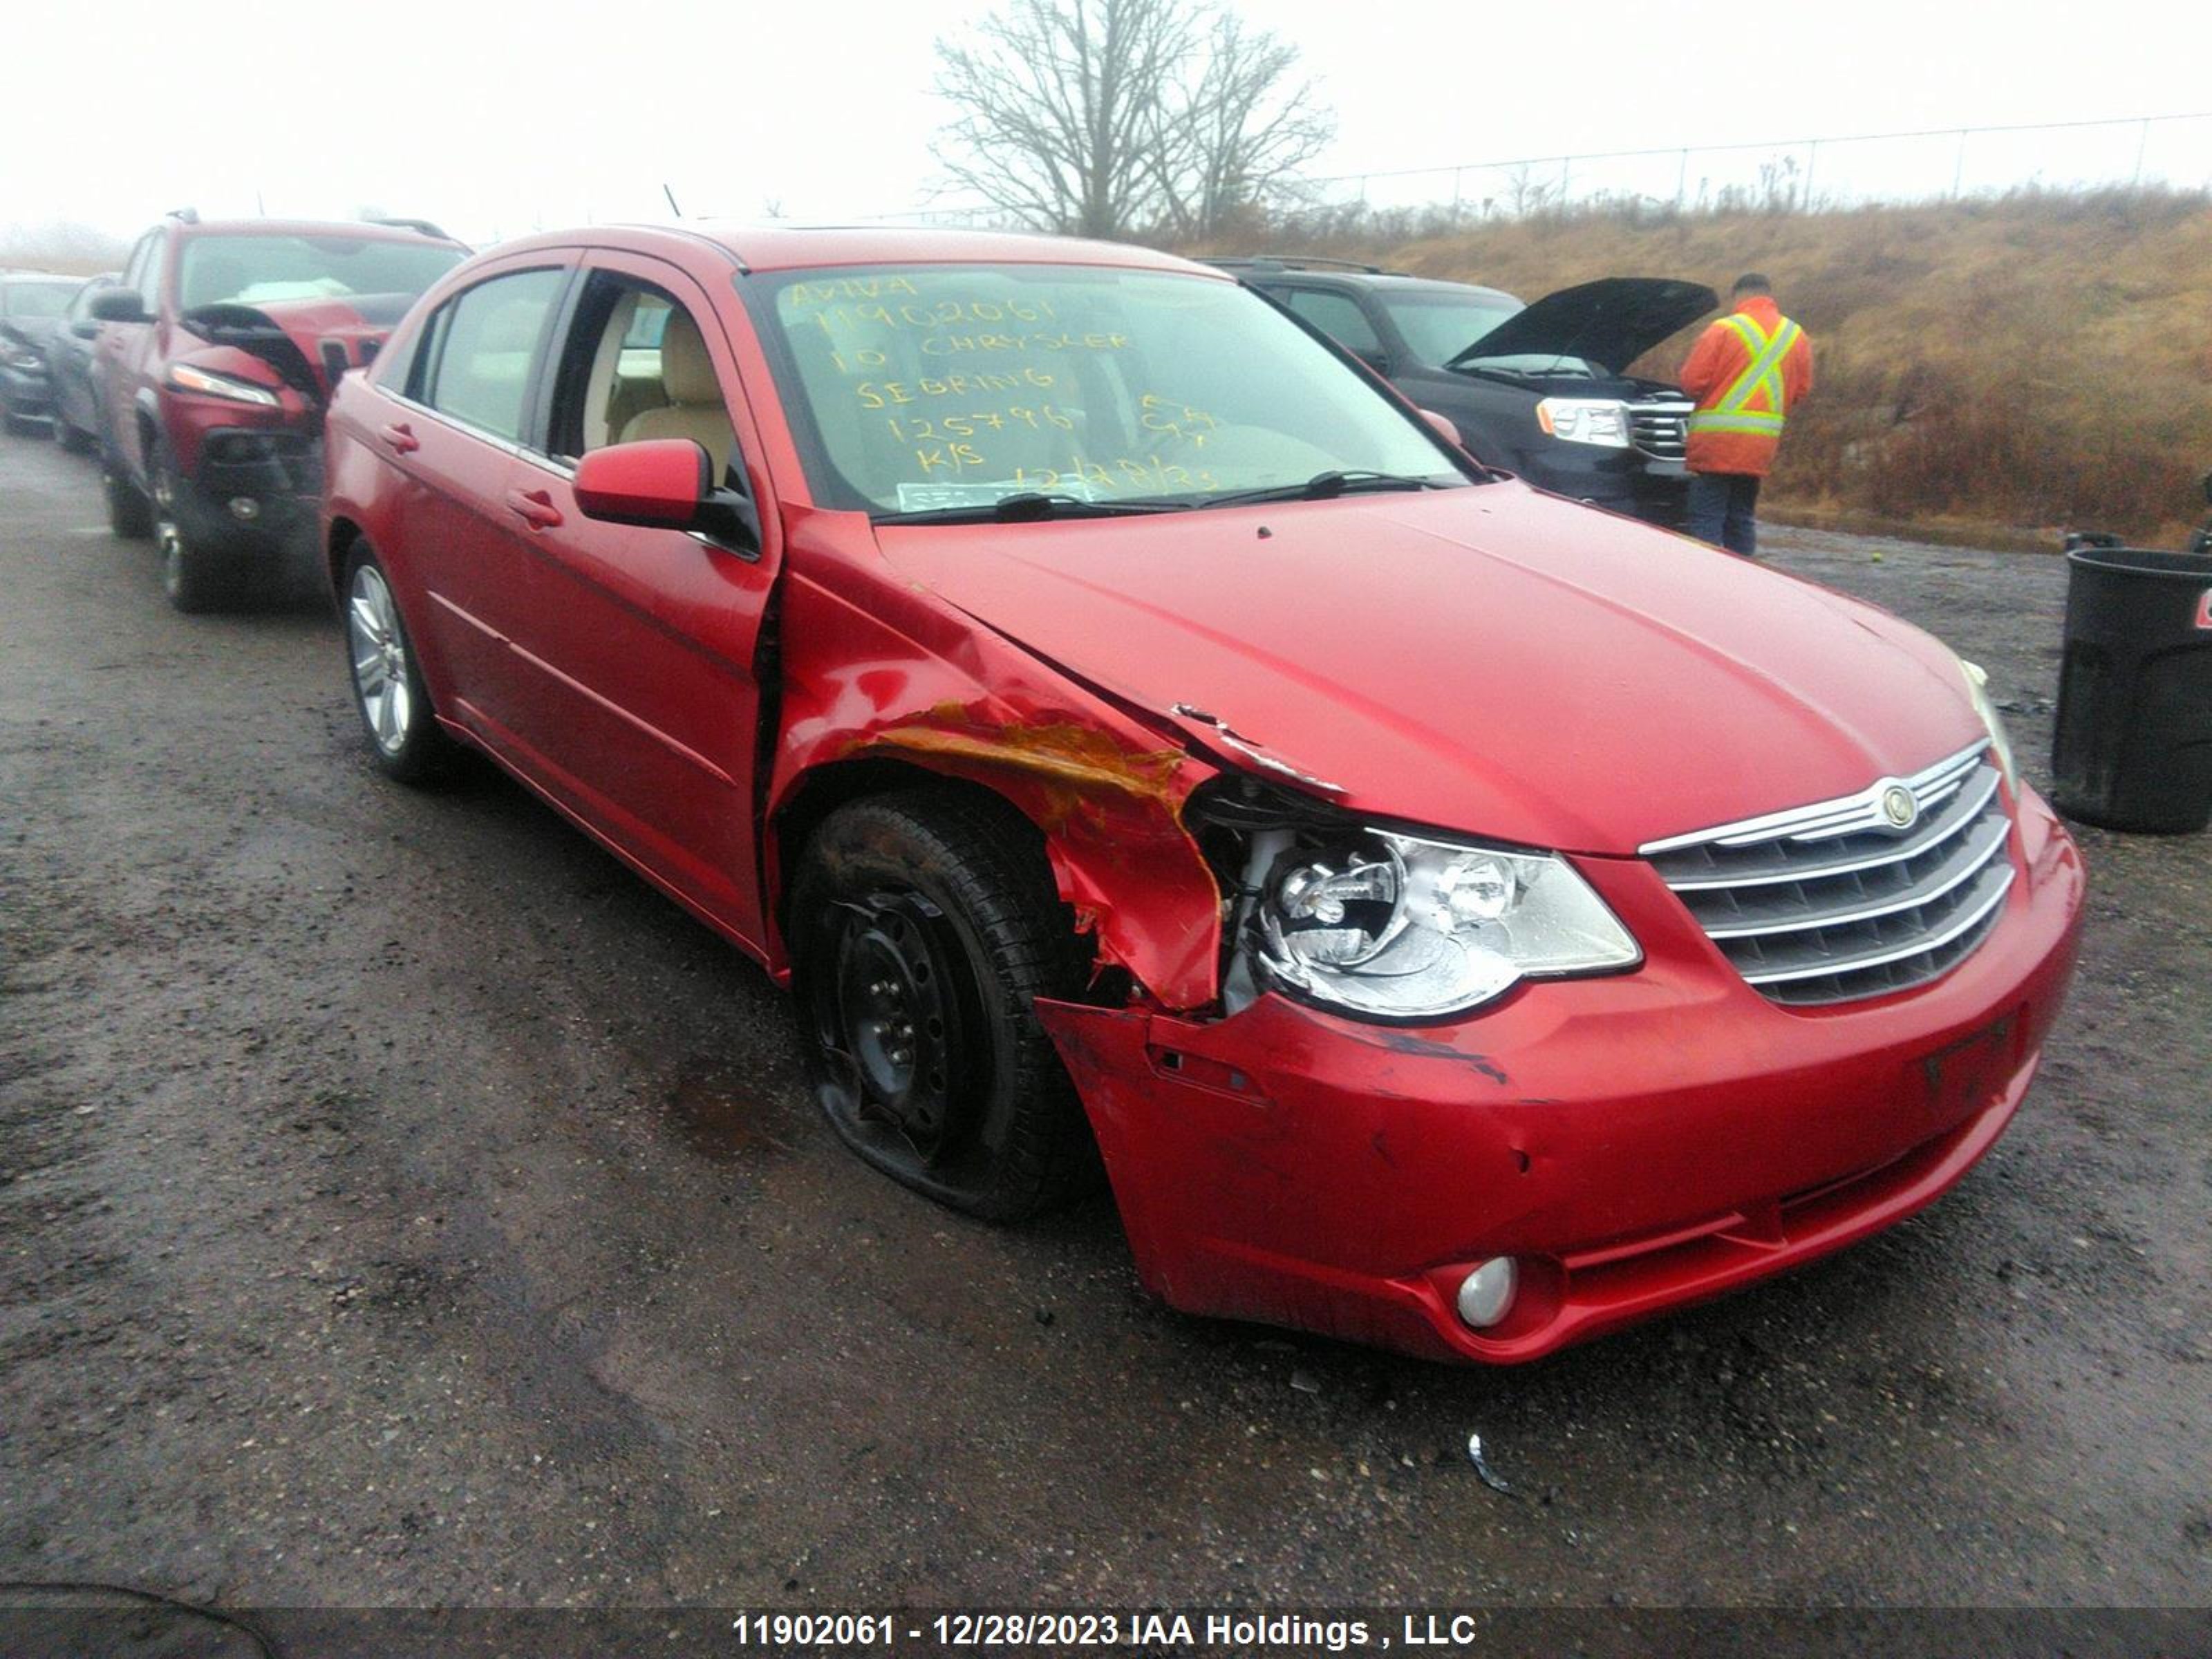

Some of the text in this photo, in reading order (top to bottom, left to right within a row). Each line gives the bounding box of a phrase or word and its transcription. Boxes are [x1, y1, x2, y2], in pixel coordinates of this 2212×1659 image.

[815, 299, 1055, 332] 11902061
[831, 332, 1129, 373] 10 CHRYSLER
[857, 368, 1053, 409] SEBRING
[889, 404, 1074, 443] 125796
